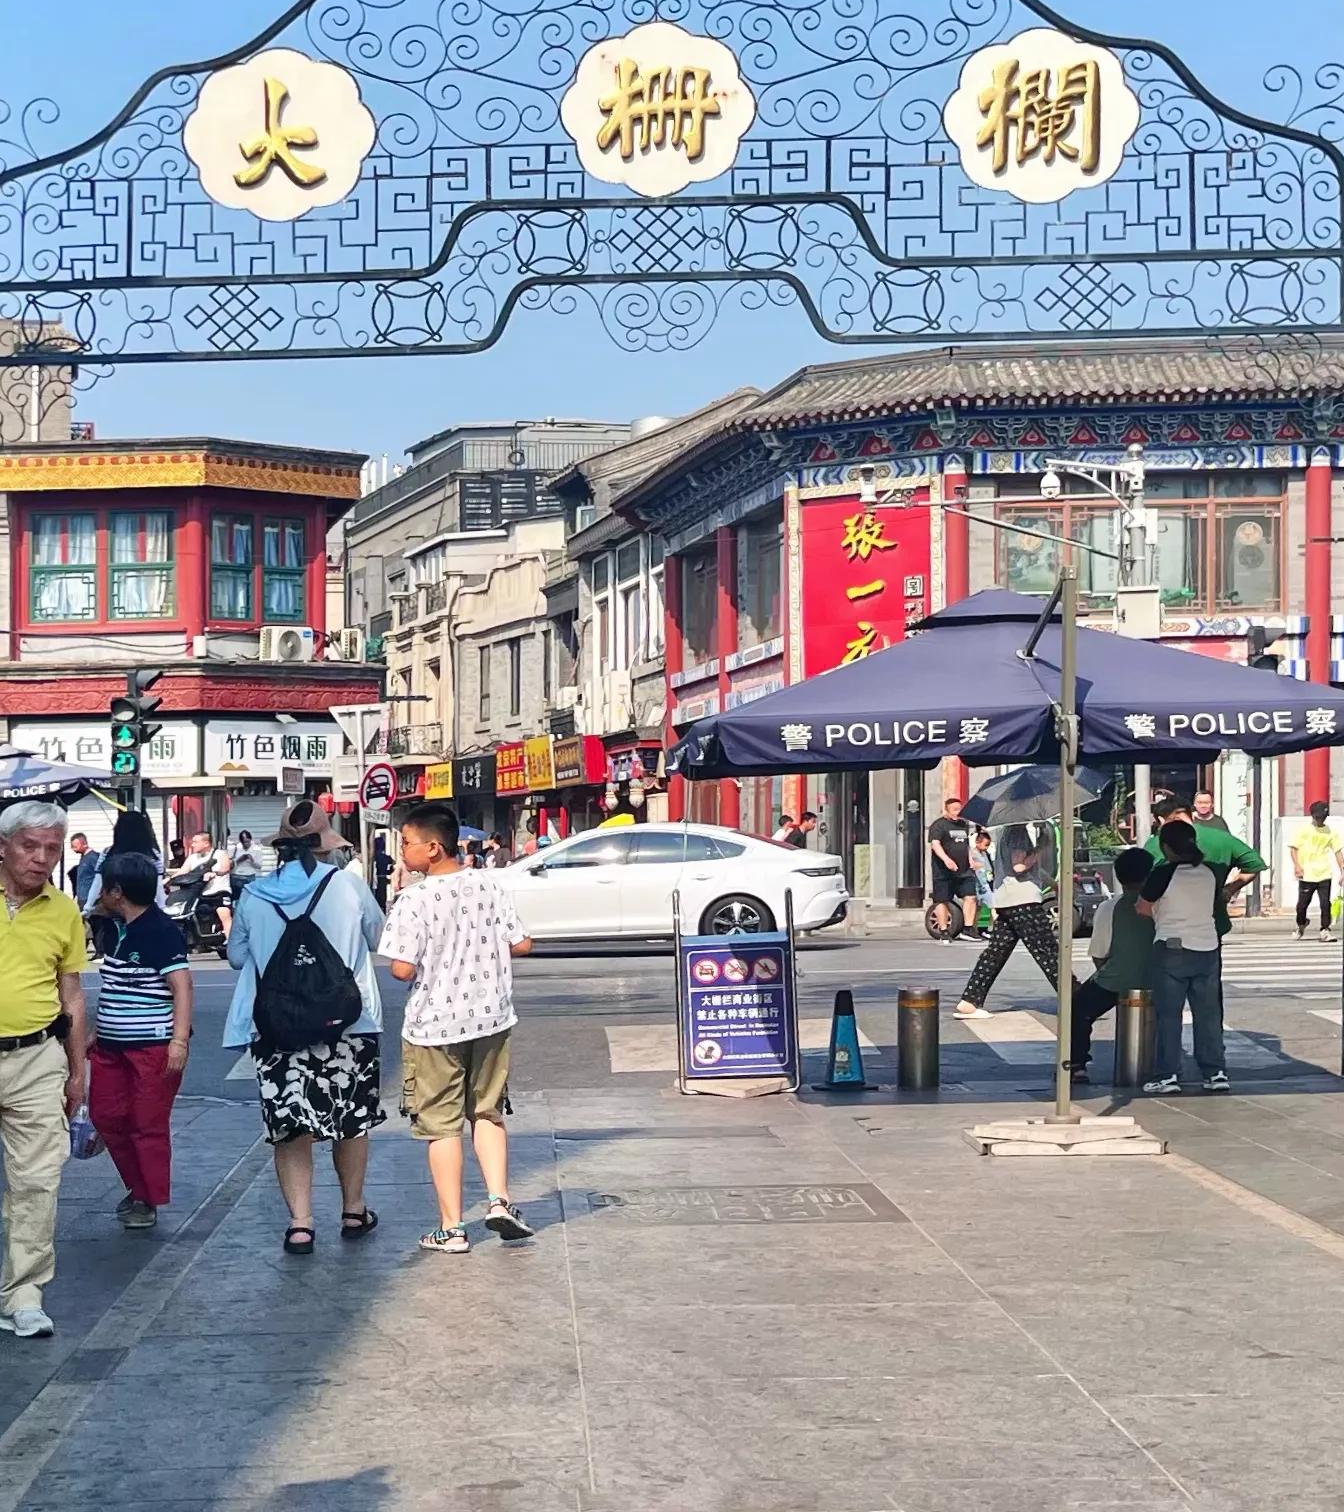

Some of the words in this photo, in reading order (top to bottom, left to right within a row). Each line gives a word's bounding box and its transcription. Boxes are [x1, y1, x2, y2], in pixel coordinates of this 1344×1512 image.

[780, 723, 813, 752] 警
[825, 720, 947, 748] POLICE
[958, 717, 990, 744] 察
[1124, 713, 1156, 738] 警
[1169, 710, 1293, 737] POLICE
[1305, 707, 1337, 735] 察
[39, 735, 177, 762] 竹色雨
[225, 733, 329, 760] 竹色烟雨
[3, 784, 47, 799] POLICE
[701, 993, 773, 1006] 大栅栏商业街区
[697, 1007, 780, 1021] 禁止各种车辆通行
